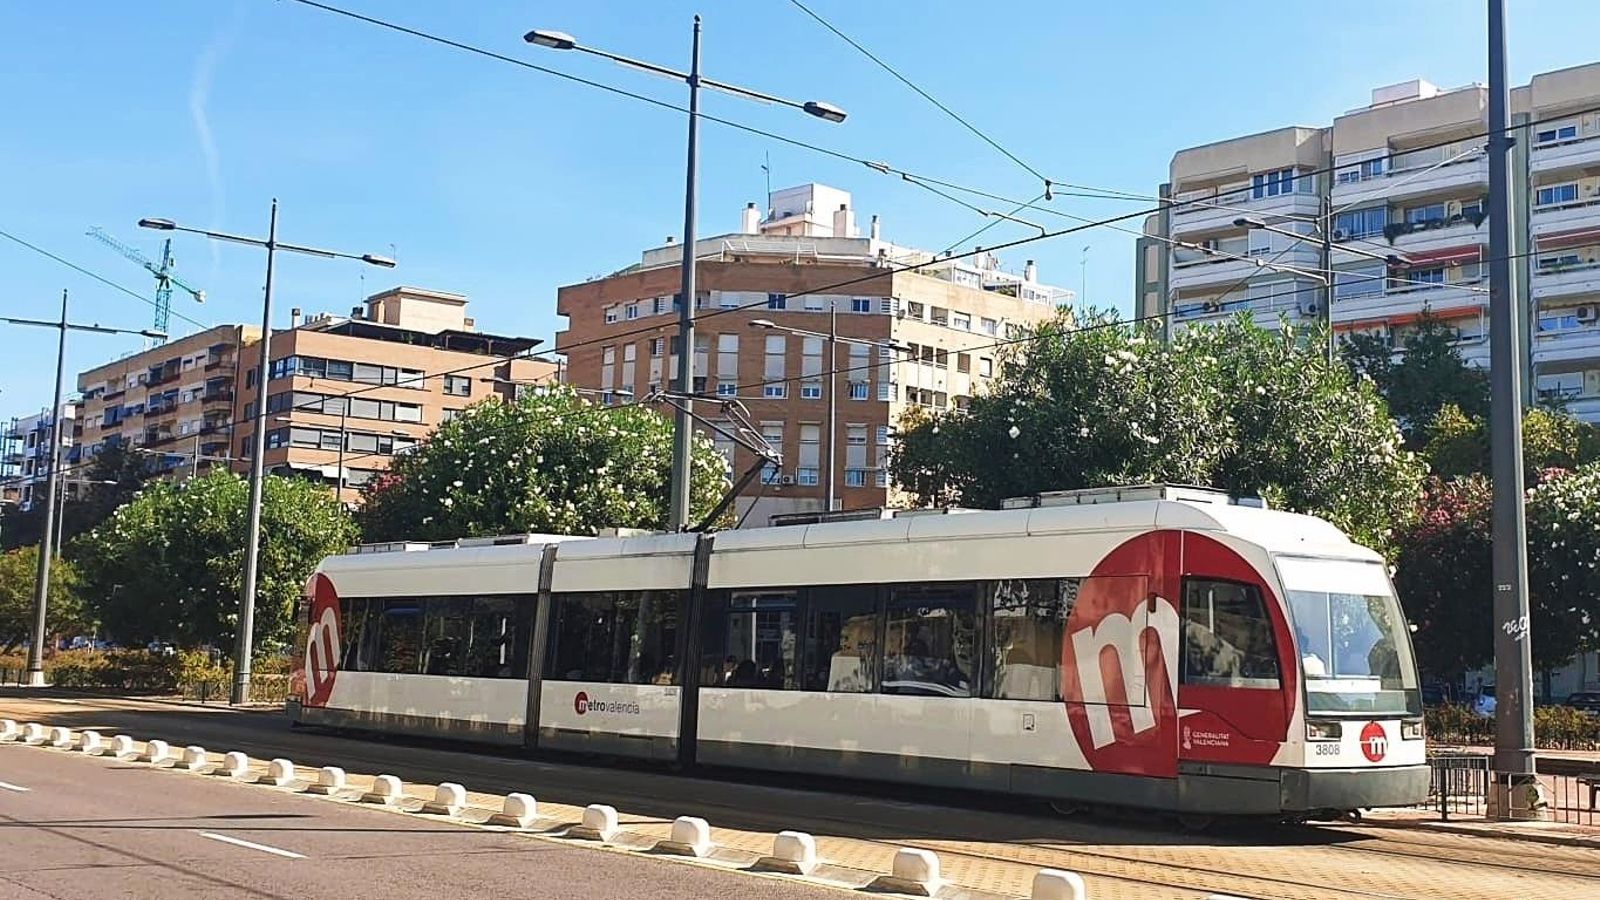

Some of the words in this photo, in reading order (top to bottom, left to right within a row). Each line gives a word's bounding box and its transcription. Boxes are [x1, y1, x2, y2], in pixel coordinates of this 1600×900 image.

[1071, 596, 1180, 750] m
[577, 696, 640, 715] metrovalencia
[1192, 731, 1228, 739] GENERALITAT
[1192, 738, 1228, 746] VALENCIANA
[1315, 744, 1341, 756] 3808
